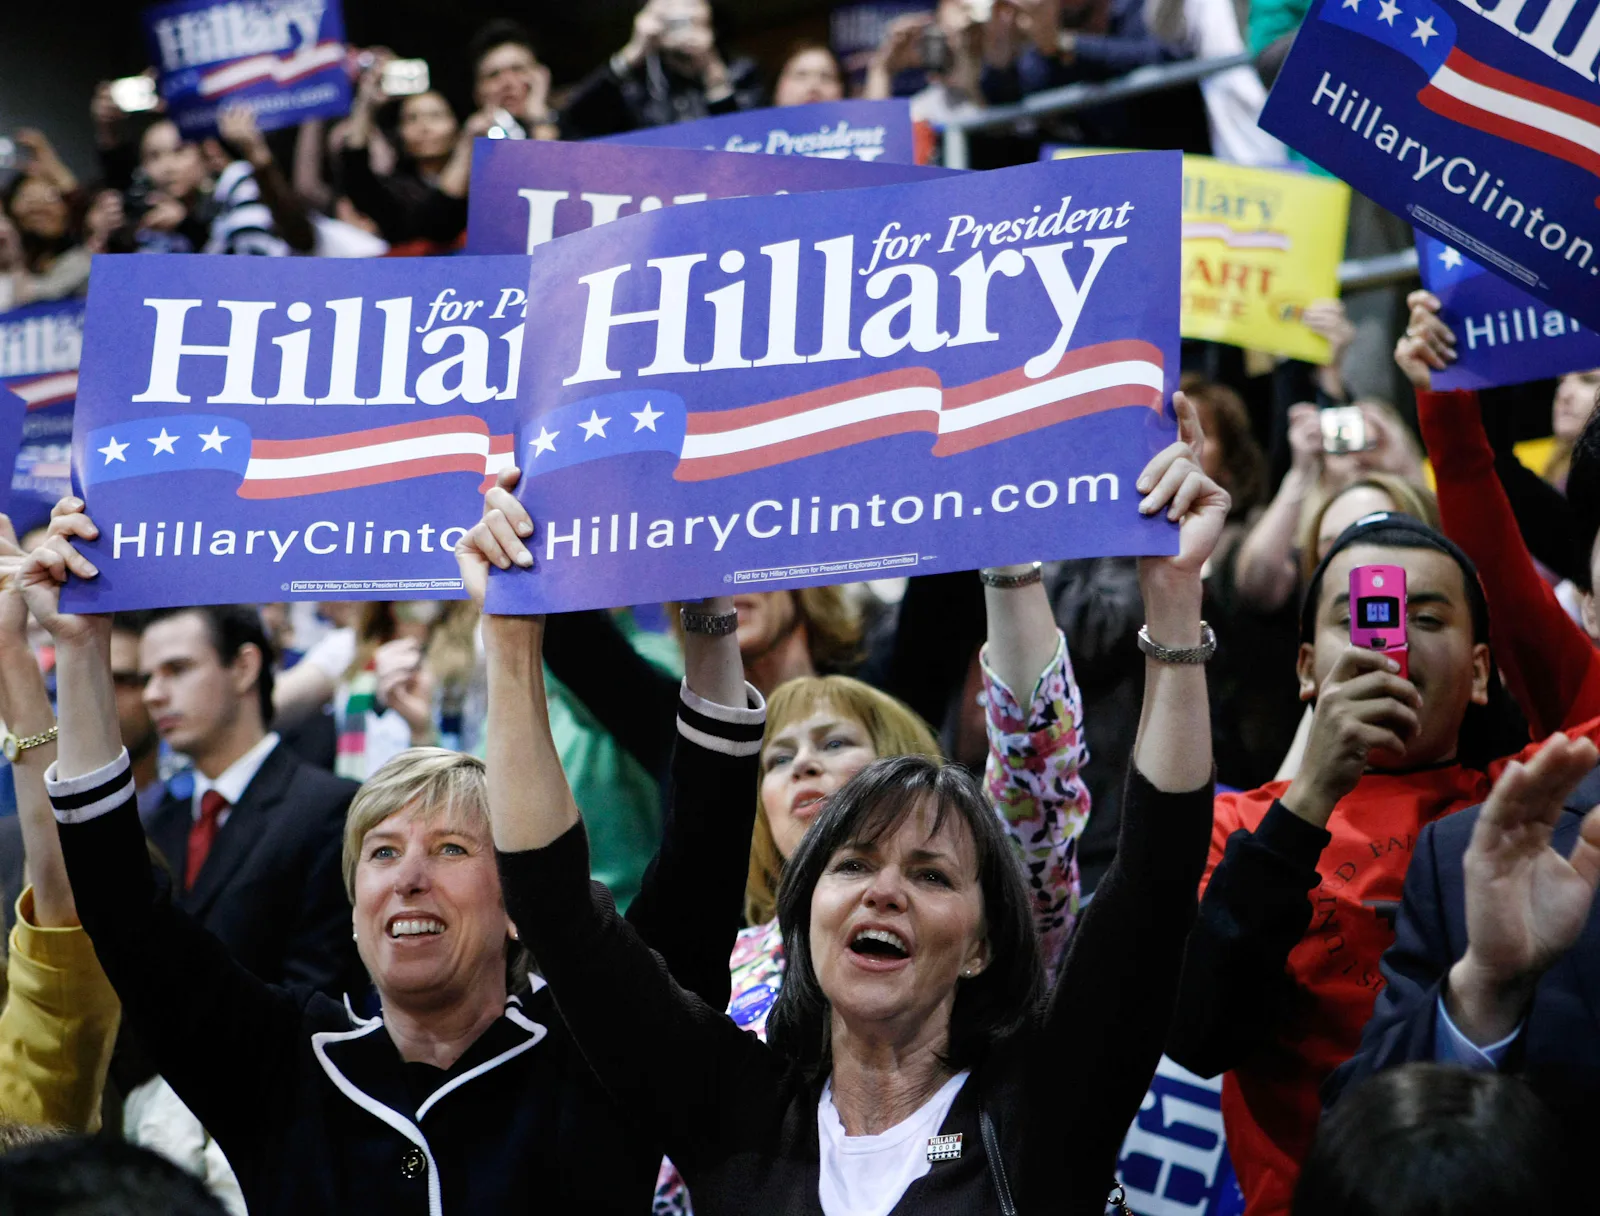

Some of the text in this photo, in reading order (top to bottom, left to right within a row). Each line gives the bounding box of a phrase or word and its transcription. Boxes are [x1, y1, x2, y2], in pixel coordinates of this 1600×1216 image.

[155, 2, 327, 72] Hillary
[765, 120, 887, 155] President
[858, 195, 1135, 276] for President
[415, 288, 484, 333] for
[562, 233, 1129, 387] Hillary
[546, 472, 1120, 560] HillaryClinton.com
[112, 521, 467, 563] HillaryClinto
[294, 582, 307, 590] Paid
[308, 582, 316, 590] for
[324, 582, 342, 590] Hillary
[399, 581, 429, 589] Exploratory
[769, 570, 788, 578] Hillary
[789, 567, 810, 576] Clinton
[820, 563, 848, 572] President
[848, 560, 881, 570] Exploratory
[882, 556, 914, 566] Committee
[930, 1135, 958, 1145] HILLARY
[932, 1143, 957, 1152] 2008
